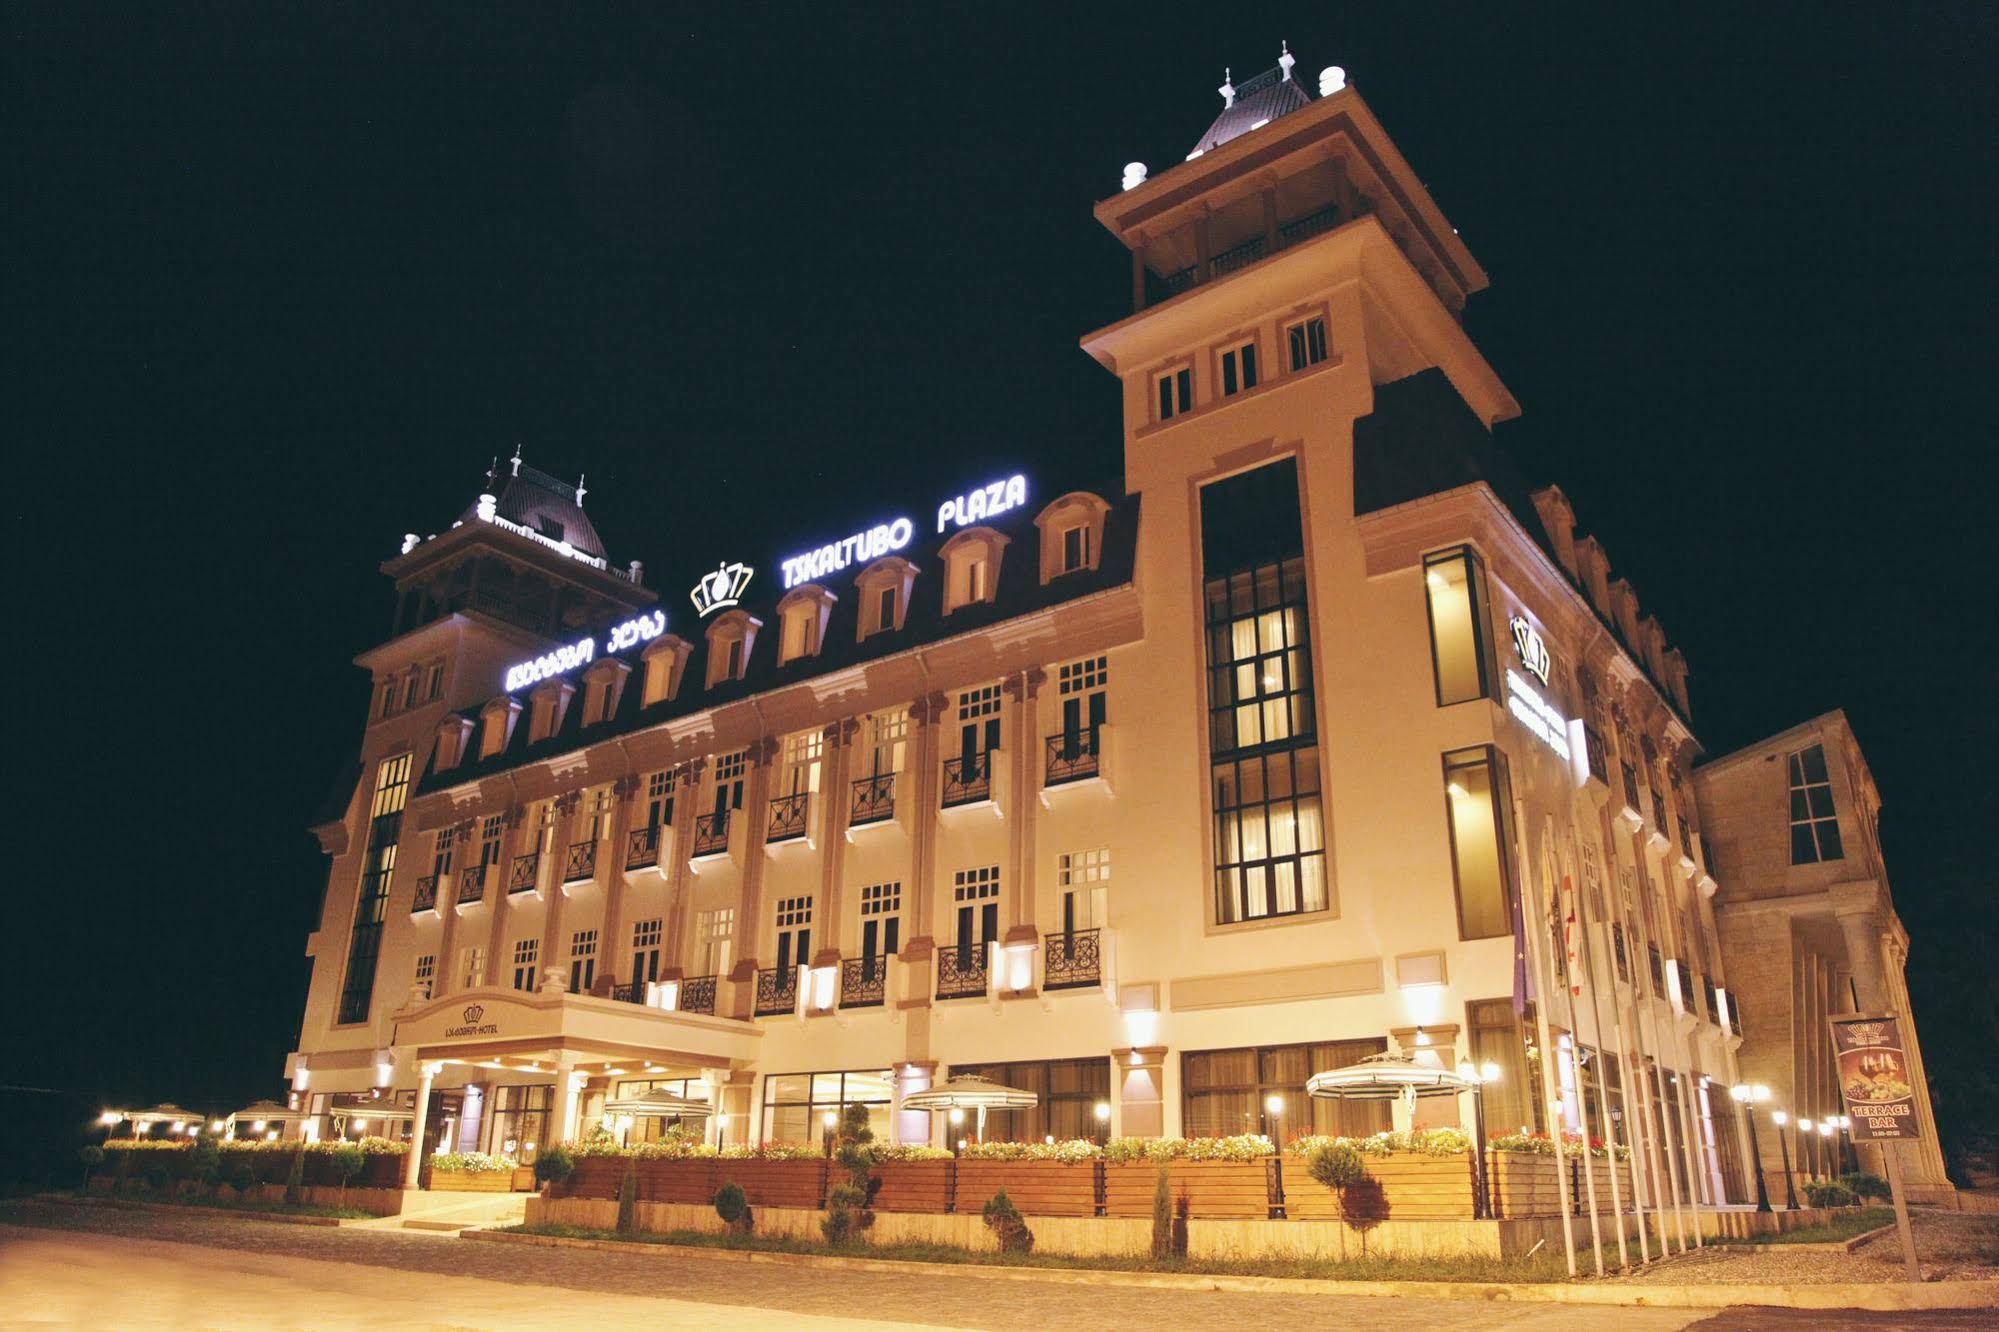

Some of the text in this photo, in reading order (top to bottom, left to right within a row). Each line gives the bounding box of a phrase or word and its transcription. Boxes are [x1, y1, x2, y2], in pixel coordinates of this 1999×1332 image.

[782, 474, 1026, 589] TSKALTUBO PLAZA
[606, 609, 665, 653] პლაზა
[1852, 1104, 1909, 1117] TERRACE
[1869, 1117, 1897, 1128] BAR
